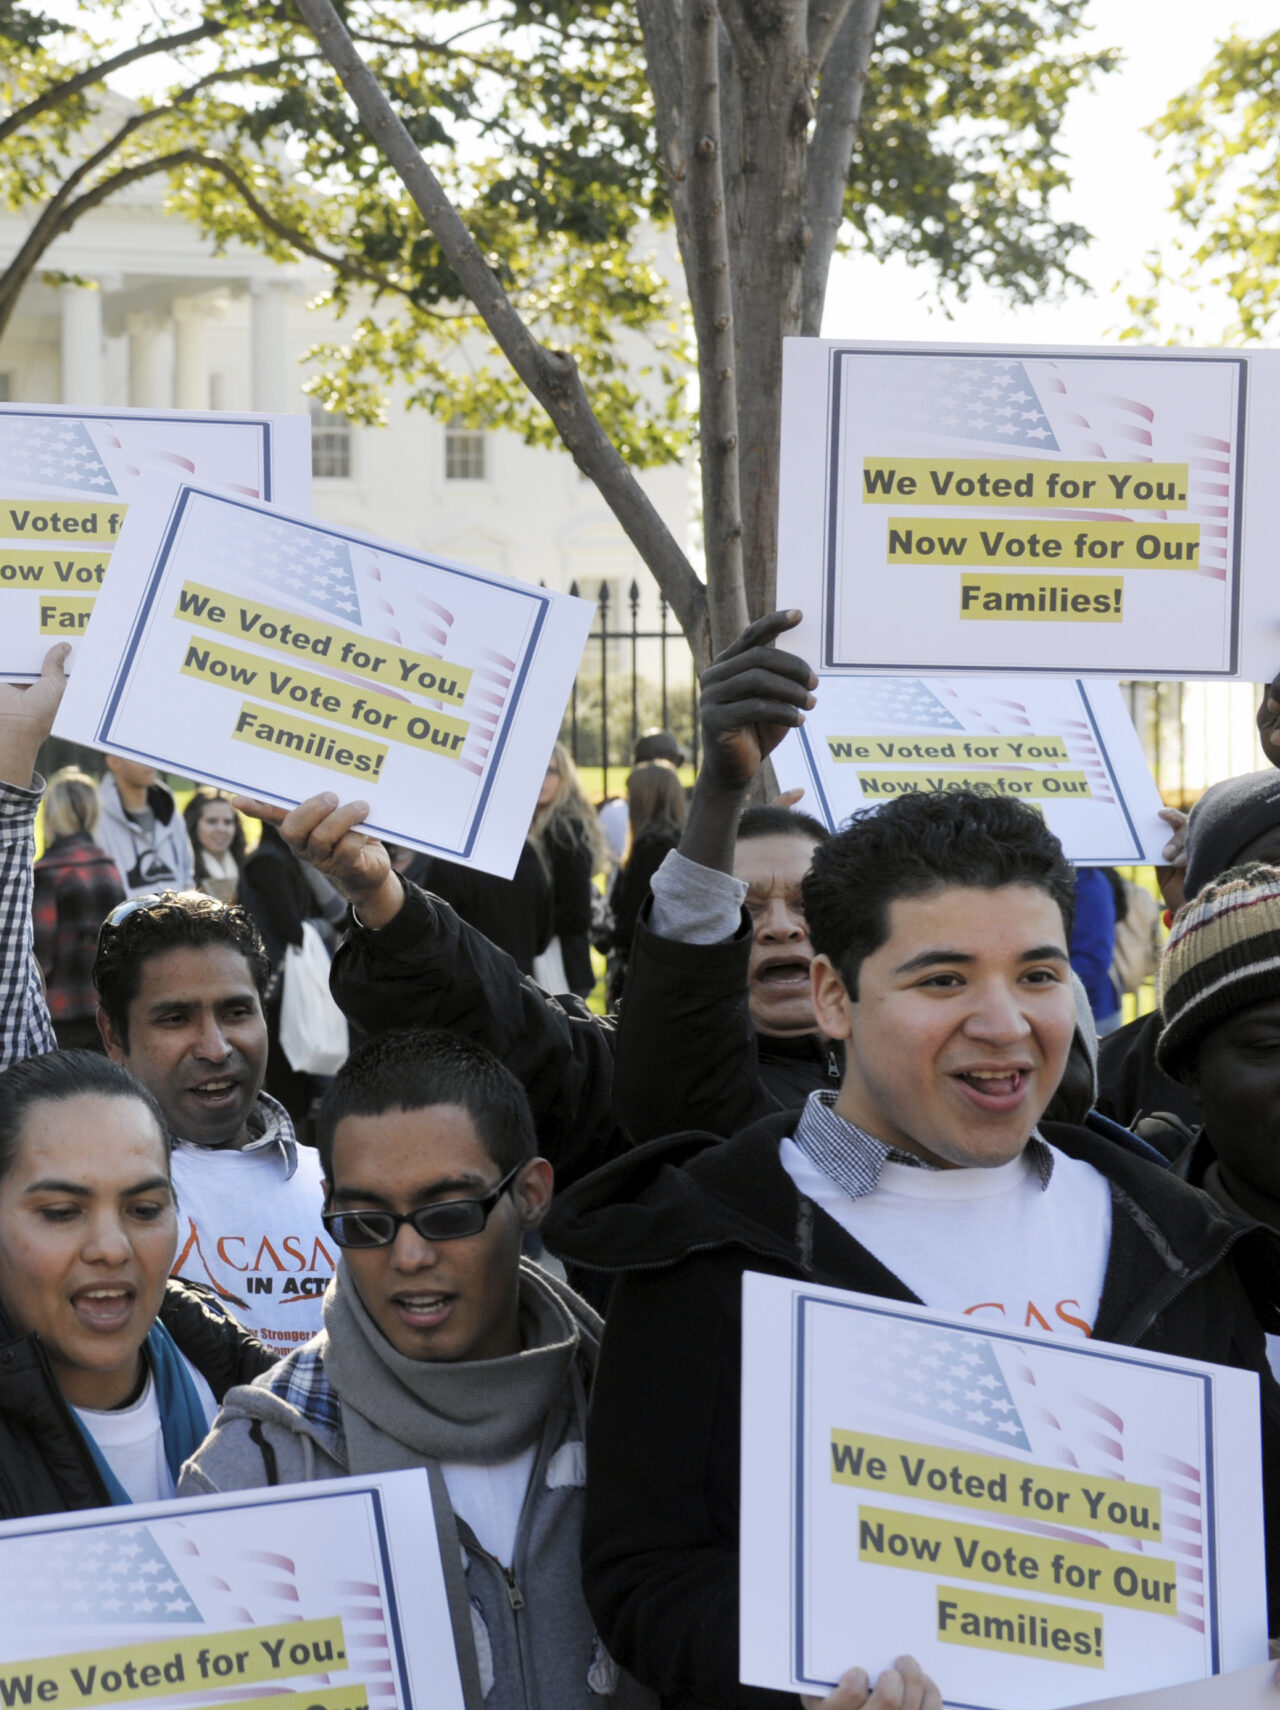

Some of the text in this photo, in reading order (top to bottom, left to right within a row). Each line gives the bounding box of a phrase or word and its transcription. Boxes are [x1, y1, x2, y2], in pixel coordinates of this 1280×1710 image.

[864, 470, 1185, 500] We Voted for You.
[10, 511, 97, 533] Voted
[889, 530, 1199, 560] Now Vote for Our
[54, 562, 105, 583] Vot
[962, 586, 1121, 613] Families!
[180, 591, 464, 699] We Voted for You.
[185, 646, 465, 750] Now Vote for Our
[235, 711, 384, 775] Families!
[829, 743, 1066, 758] We Voted for You.
[859, 778, 918, 793] Now
[997, 778, 1032, 793] for
[1042, 778, 1087, 792] Our
[217, 1235, 336, 1272] CASA
[247, 1278, 272, 1294] IN
[261, 1328, 310, 1341] Stronger
[832, 1443, 1159, 1530] We Voted for You.
[861, 1521, 1176, 1603] Now Vote for Our
[939, 1601, 1101, 1656] Families!
[71, 1654, 184, 1695] Voted
[197, 1650, 248, 1678] for
[261, 1639, 344, 1668] You.
